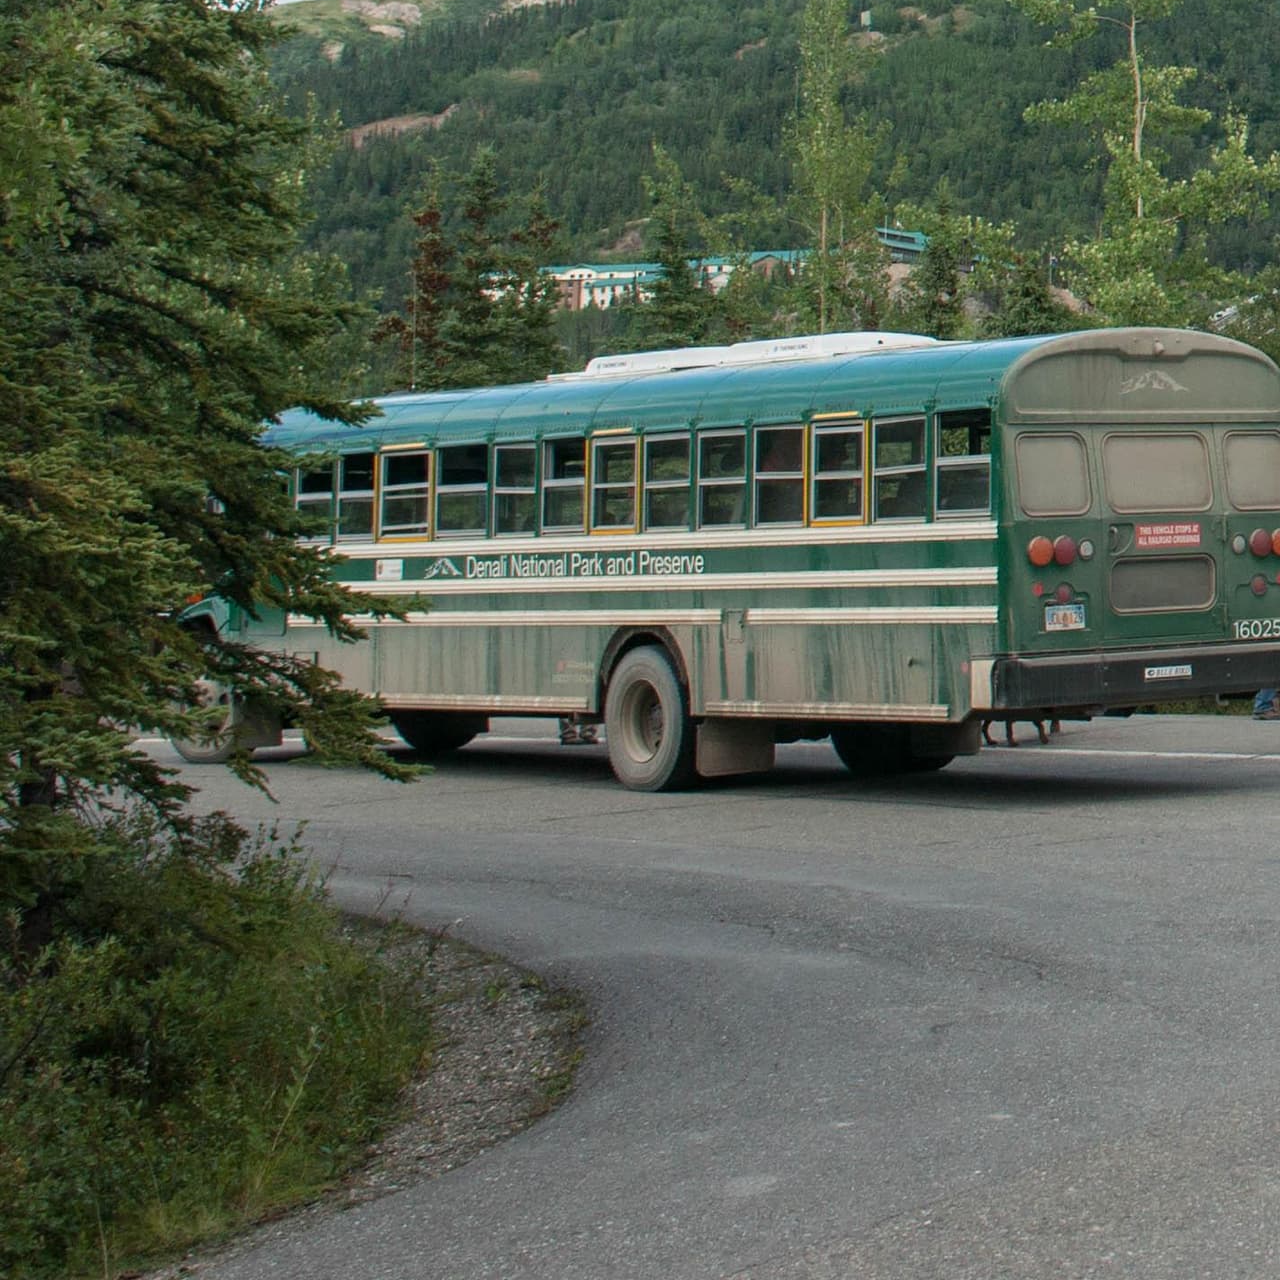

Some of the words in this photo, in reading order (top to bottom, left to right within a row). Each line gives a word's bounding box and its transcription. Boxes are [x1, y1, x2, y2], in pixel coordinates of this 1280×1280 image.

[466, 555, 507, 578] Denali
[511, 553, 567, 577] National
[571, 552, 602, 576] Park
[607, 552, 635, 575] and
[639, 550, 705, 575] Preserve
